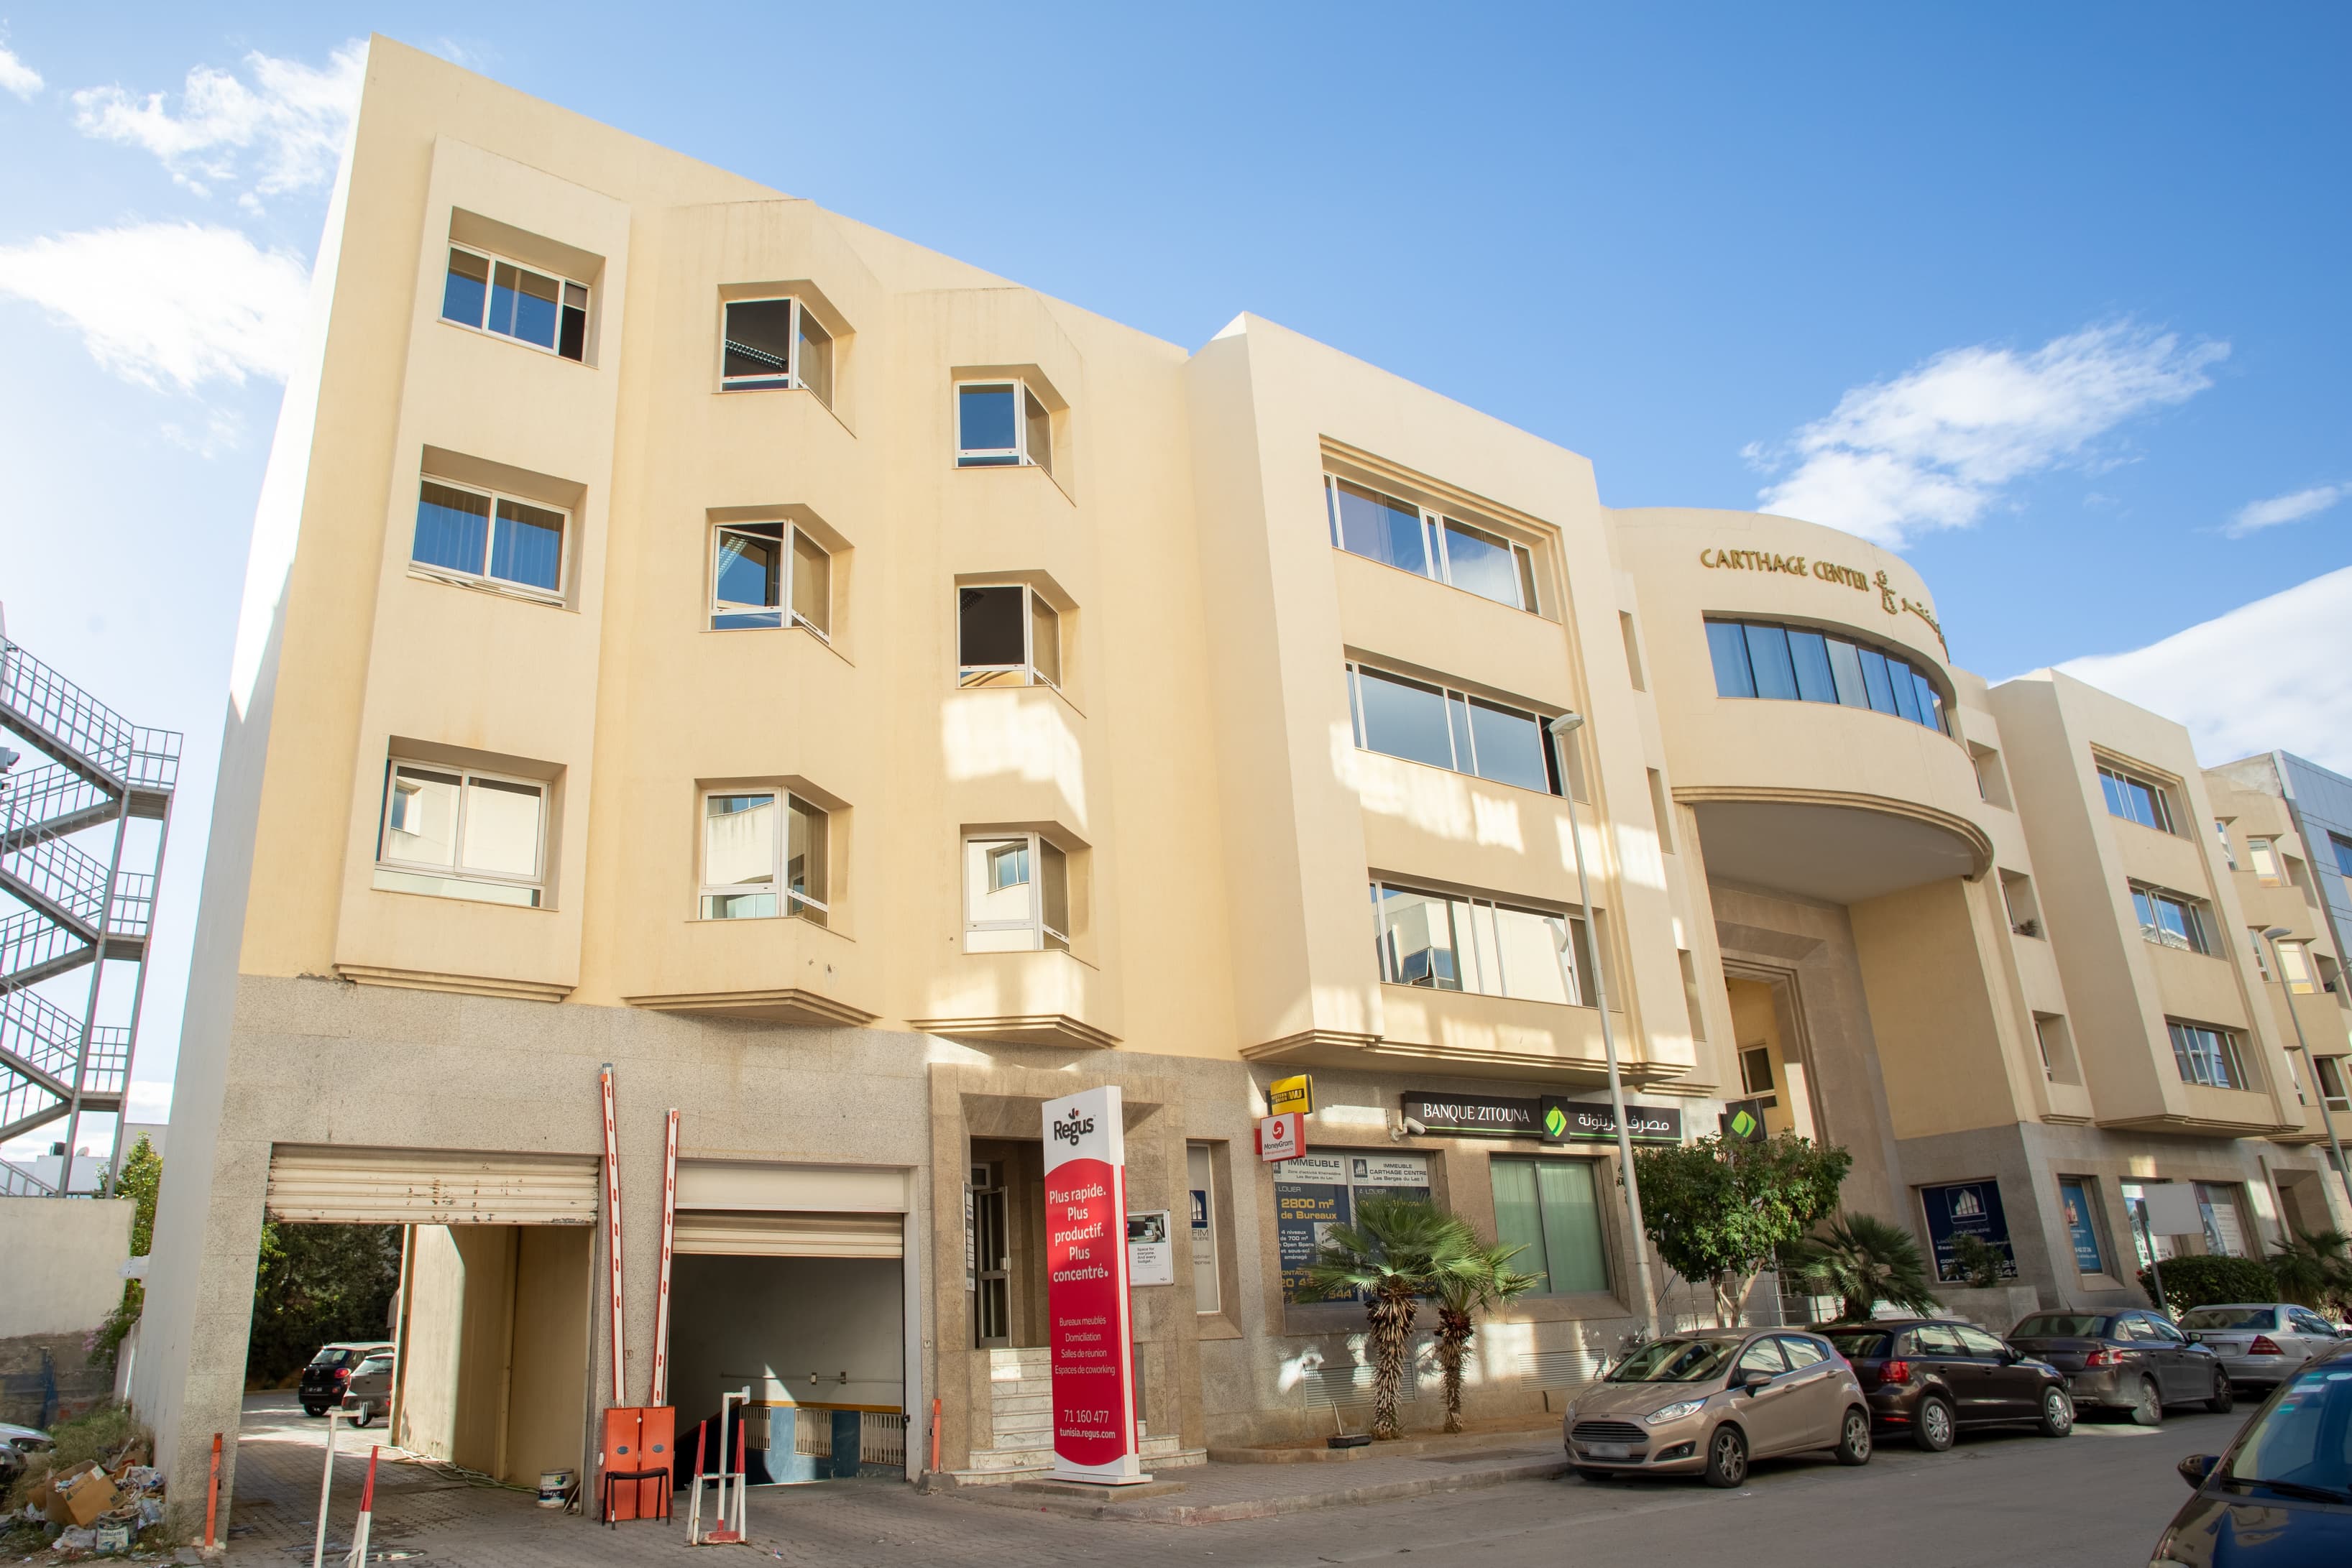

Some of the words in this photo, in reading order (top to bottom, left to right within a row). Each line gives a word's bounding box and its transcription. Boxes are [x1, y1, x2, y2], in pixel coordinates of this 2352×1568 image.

[1700, 548, 1808, 576] CARTHAGE
[1813, 561, 1869, 591] CENTER
[1423, 1103, 1474, 1122] BANQUE
[1477, 1106, 1530, 1122] ZITOUNA
[1578, 1113, 1617, 1130] زيتونة
[1627, 1115, 1669, 1133] مصرف
[1053, 1117, 1094, 1146] Regus
[1264, 1140, 1293, 1150] MoneyGram
[1288, 1158, 1340, 1168] IMMEUBLE
[1049, 1189, 1070, 1204] Plus
[1070, 1183, 1106, 1204] rapide.
[1281, 1198, 1315, 1209] 2800
[1318, 1199, 1335, 1209] m²
[1067, 1206, 1089, 1222] Plus
[1281, 1211, 1293, 1219] de
[1296, 1211, 1337, 1219] Bureaux
[1055, 1222, 1104, 1247] productif.
[1069, 1246, 1090, 1260] Plus
[1053, 1263, 1108, 1283] concentré.
[1059, 1317, 1081, 1327] Bureaux
[1081, 1316, 1106, 1326] meublés
[1065, 1332, 1101, 1342] Domiciliation
[1061, 1349, 1077, 1358] Salles
[1077, 1349, 1085, 1357] de
[1085, 1348, 1107, 1357] réunion
[1055, 1365, 1077, 1376] Espaces
[1077, 1365, 1085, 1374] de
[1085, 1365, 1116, 1376] coworking
[1064, 1409, 1075, 1422] 71
[1076, 1409, 1092, 1423] 160
[1093, 1410, 1109, 1424] 477
[1060, 1427, 1116, 1440] tunisia.regus.com
